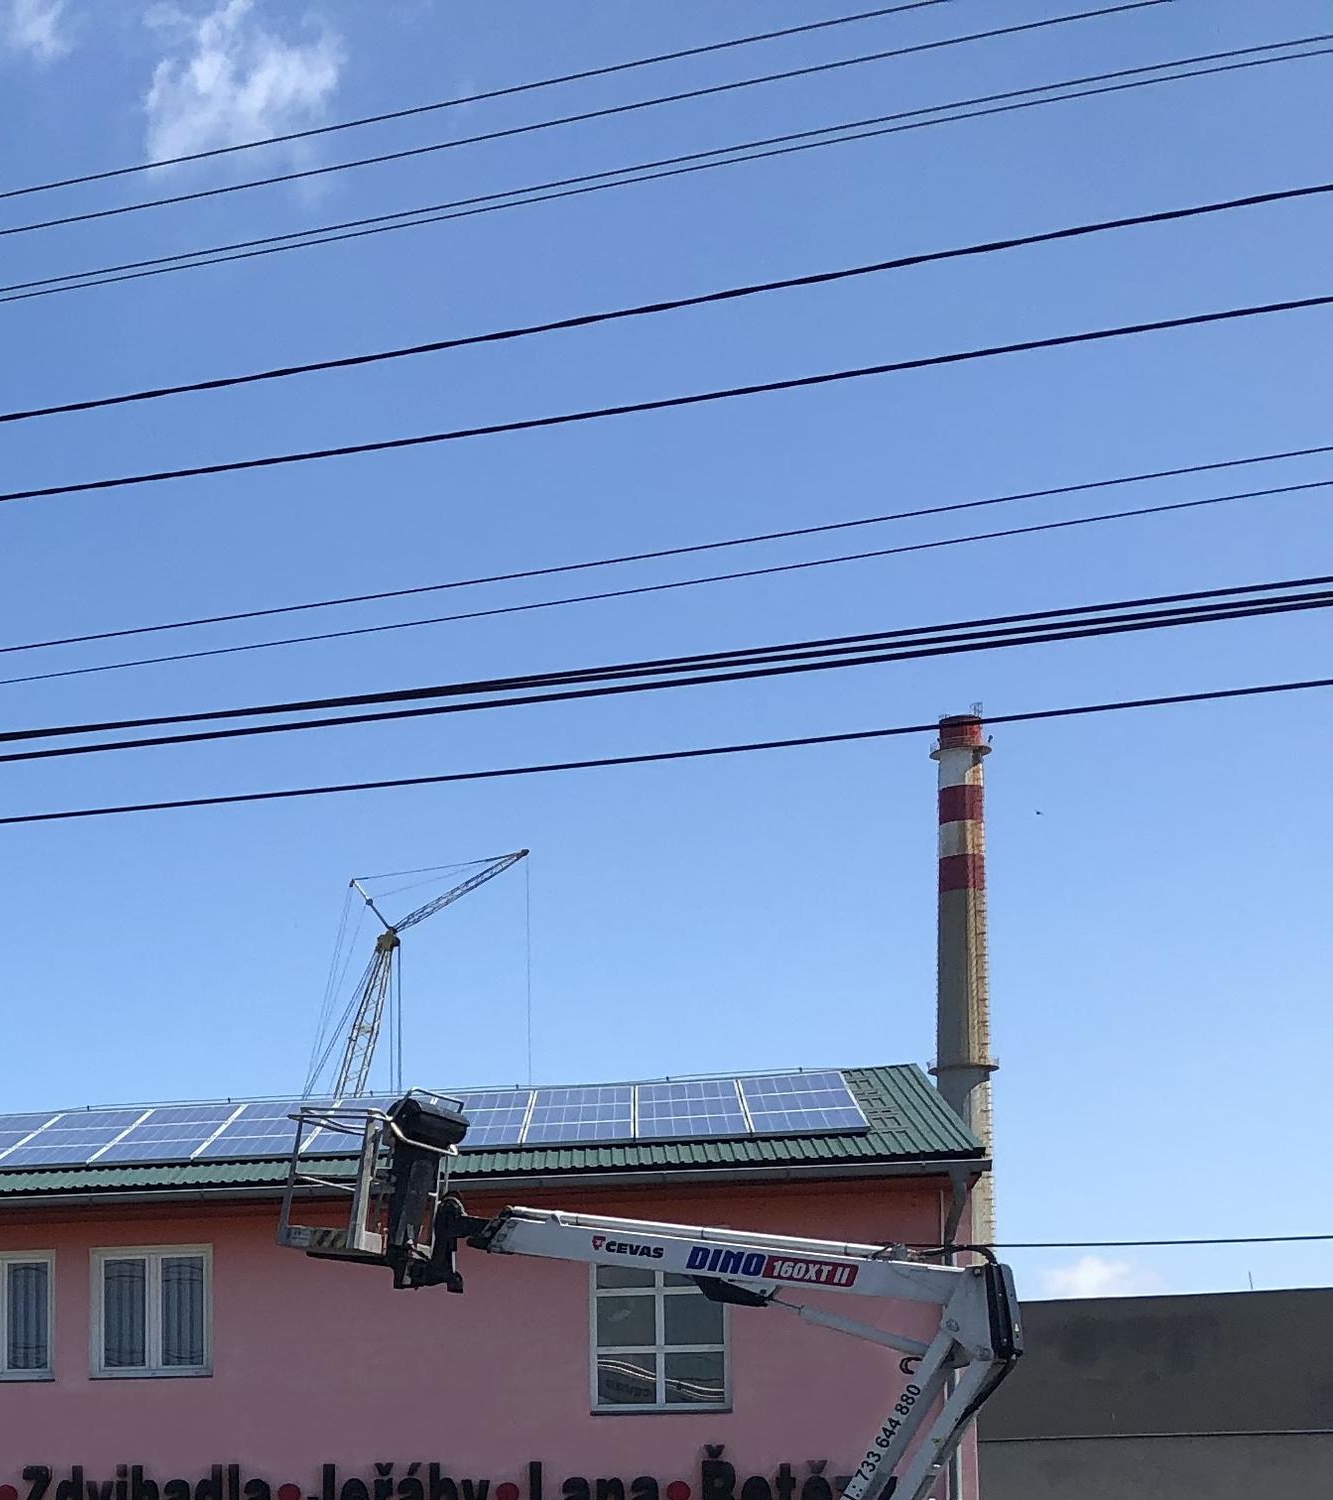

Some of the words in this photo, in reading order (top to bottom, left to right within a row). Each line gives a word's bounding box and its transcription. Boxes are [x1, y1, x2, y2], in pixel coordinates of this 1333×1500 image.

[686, 1246, 767, 1277] DINO
[773, 1260, 830, 1282] 160XT
[855, 1451, 881, 1481] 733
[875, 1417, 902, 1448] 644
[895, 1384, 921, 1415] 880
